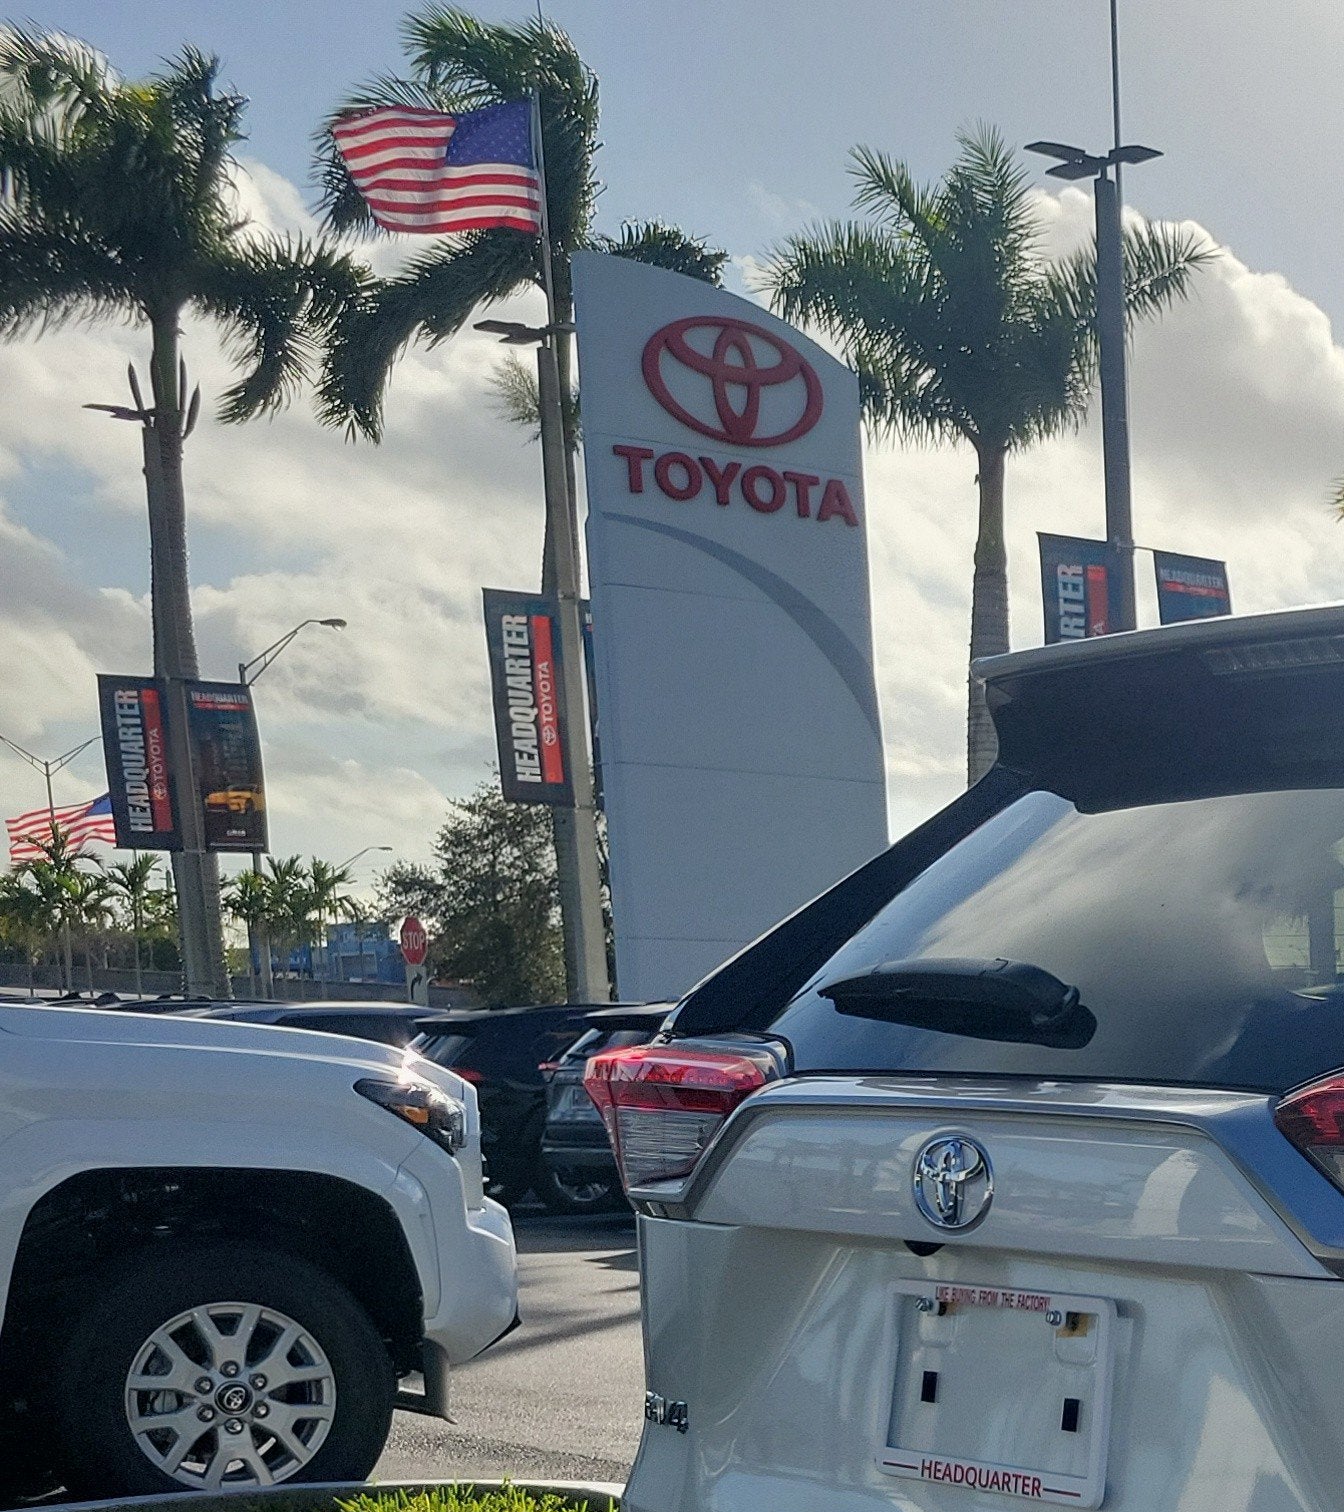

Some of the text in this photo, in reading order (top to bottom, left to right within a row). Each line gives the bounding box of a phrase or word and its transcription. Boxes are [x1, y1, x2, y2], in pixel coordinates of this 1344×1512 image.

[612, 444, 859, 527] TOYOTA
[502, 614, 542, 782] HEADQUARTER
[538, 661, 554, 723] TOYOTA
[114, 689, 154, 832] HEADQUARTER
[150, 728, 164, 780] TOYOTA
[402, 931, 426, 950] STOP
[979, 1289, 998, 1306] FROM
[1001, 1291, 1015, 1308] THE
[920, 1458, 1042, 1498] HEADQUARTER
